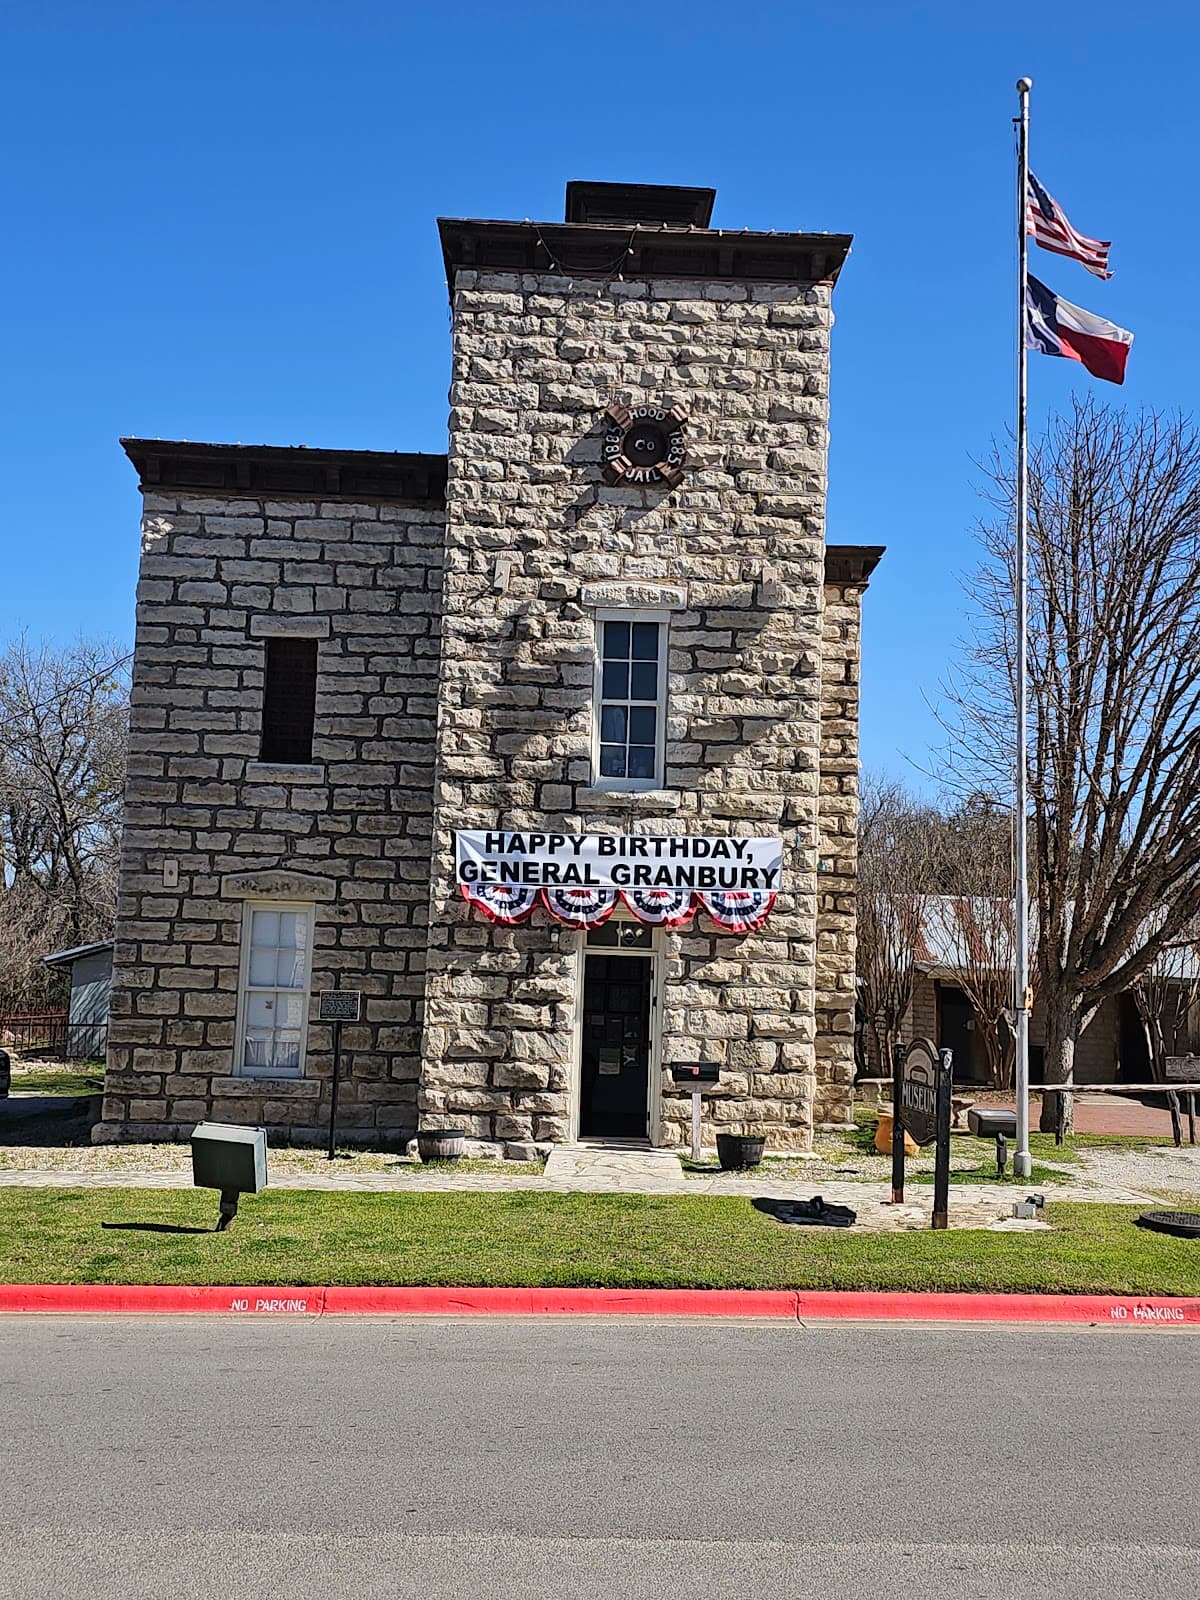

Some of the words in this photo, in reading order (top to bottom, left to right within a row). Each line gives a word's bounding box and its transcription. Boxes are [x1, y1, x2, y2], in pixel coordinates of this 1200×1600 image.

[628, 407, 665, 420] HOOD
[668, 432, 685, 465] 1885
[625, 469, 661, 482] JAIL
[485, 833, 587, 855] HAPPY
[600, 836, 753, 864] BIRTHDAY,
[459, 861, 600, 884] GENERAL
[610, 864, 779, 889] GRANBURY
[901, 1082, 937, 1115] MUSEUM
[230, 1299, 249, 1312] NO
[255, 1299, 307, 1312] PARKING
[1110, 1306, 1128, 1319] NO
[1133, 1307, 1184, 1320] PARKING
